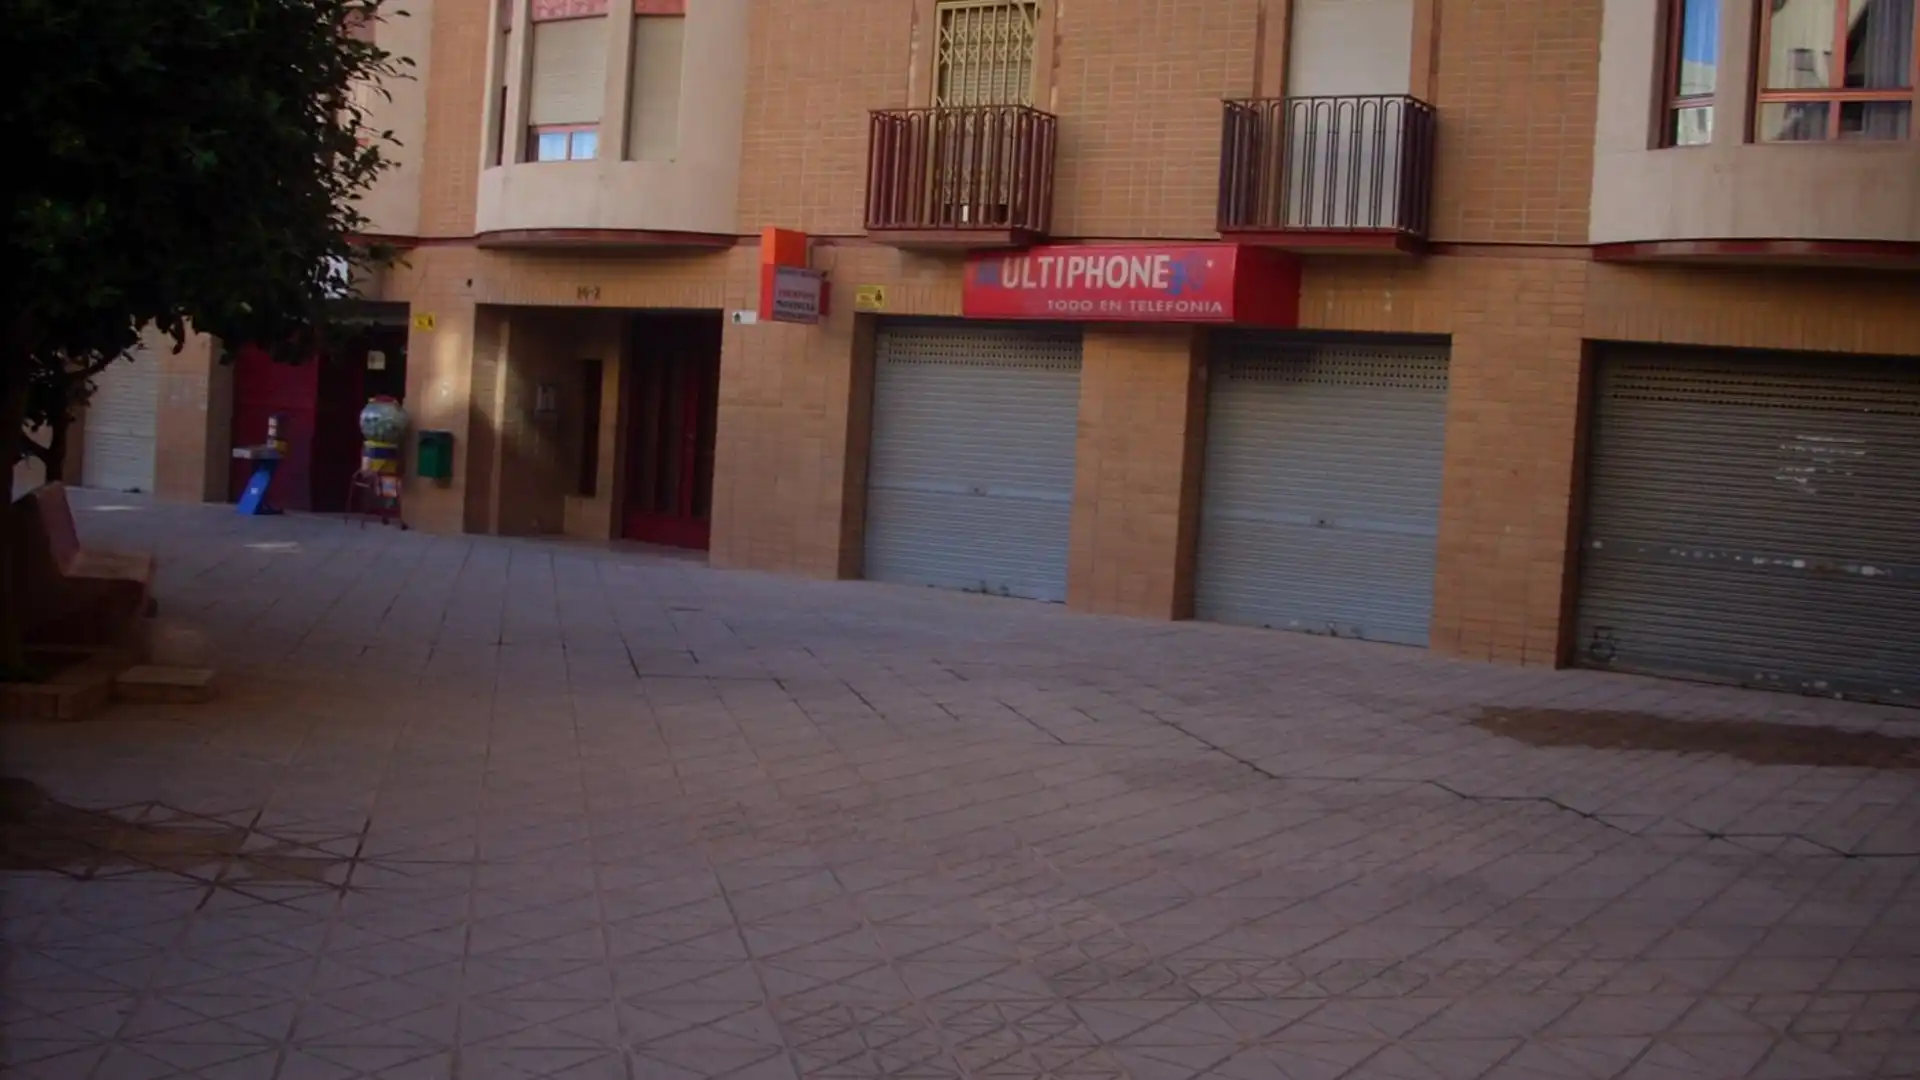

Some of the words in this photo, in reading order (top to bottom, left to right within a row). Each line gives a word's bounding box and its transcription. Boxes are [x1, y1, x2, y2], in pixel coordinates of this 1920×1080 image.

[974, 255, 1171, 289] ULTIPHONE
[1047, 299, 1093, 312] TODO
[1100, 299, 1123, 312] EN
[1130, 300, 1223, 313] TELEFONIA
